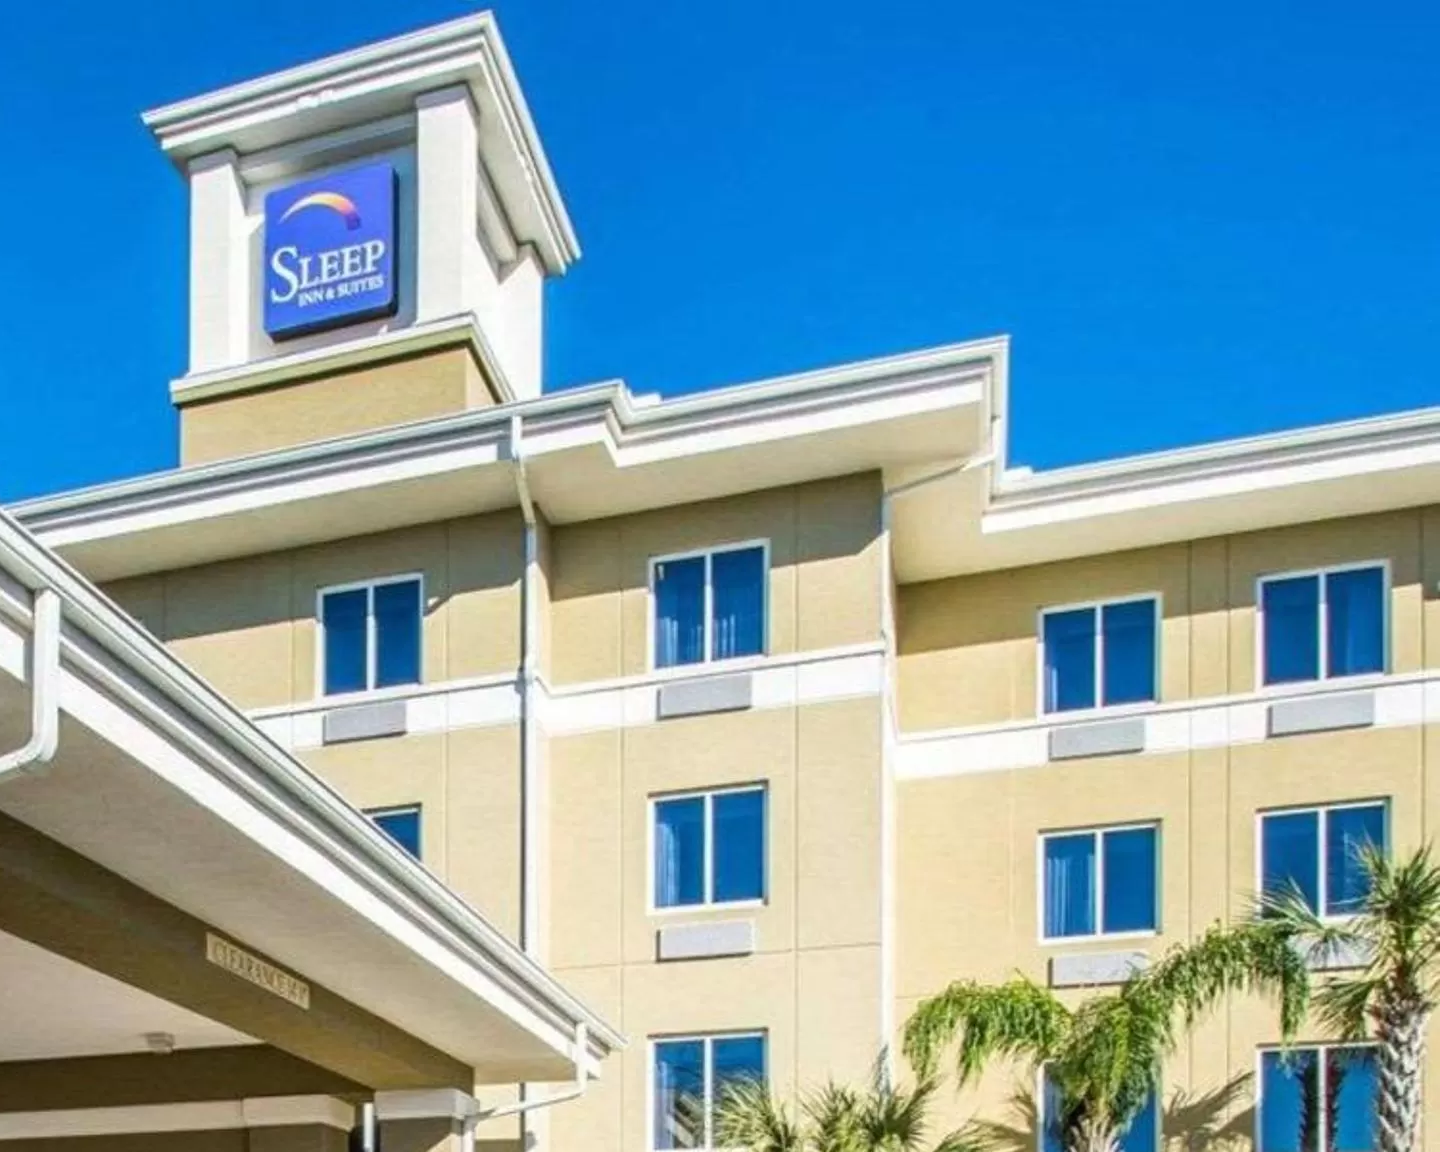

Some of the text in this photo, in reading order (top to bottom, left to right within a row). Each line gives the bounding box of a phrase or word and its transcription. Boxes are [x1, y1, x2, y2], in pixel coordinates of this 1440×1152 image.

[271, 240, 385, 303] SLEEP
[298, 274, 385, 307] INN & SUITES
